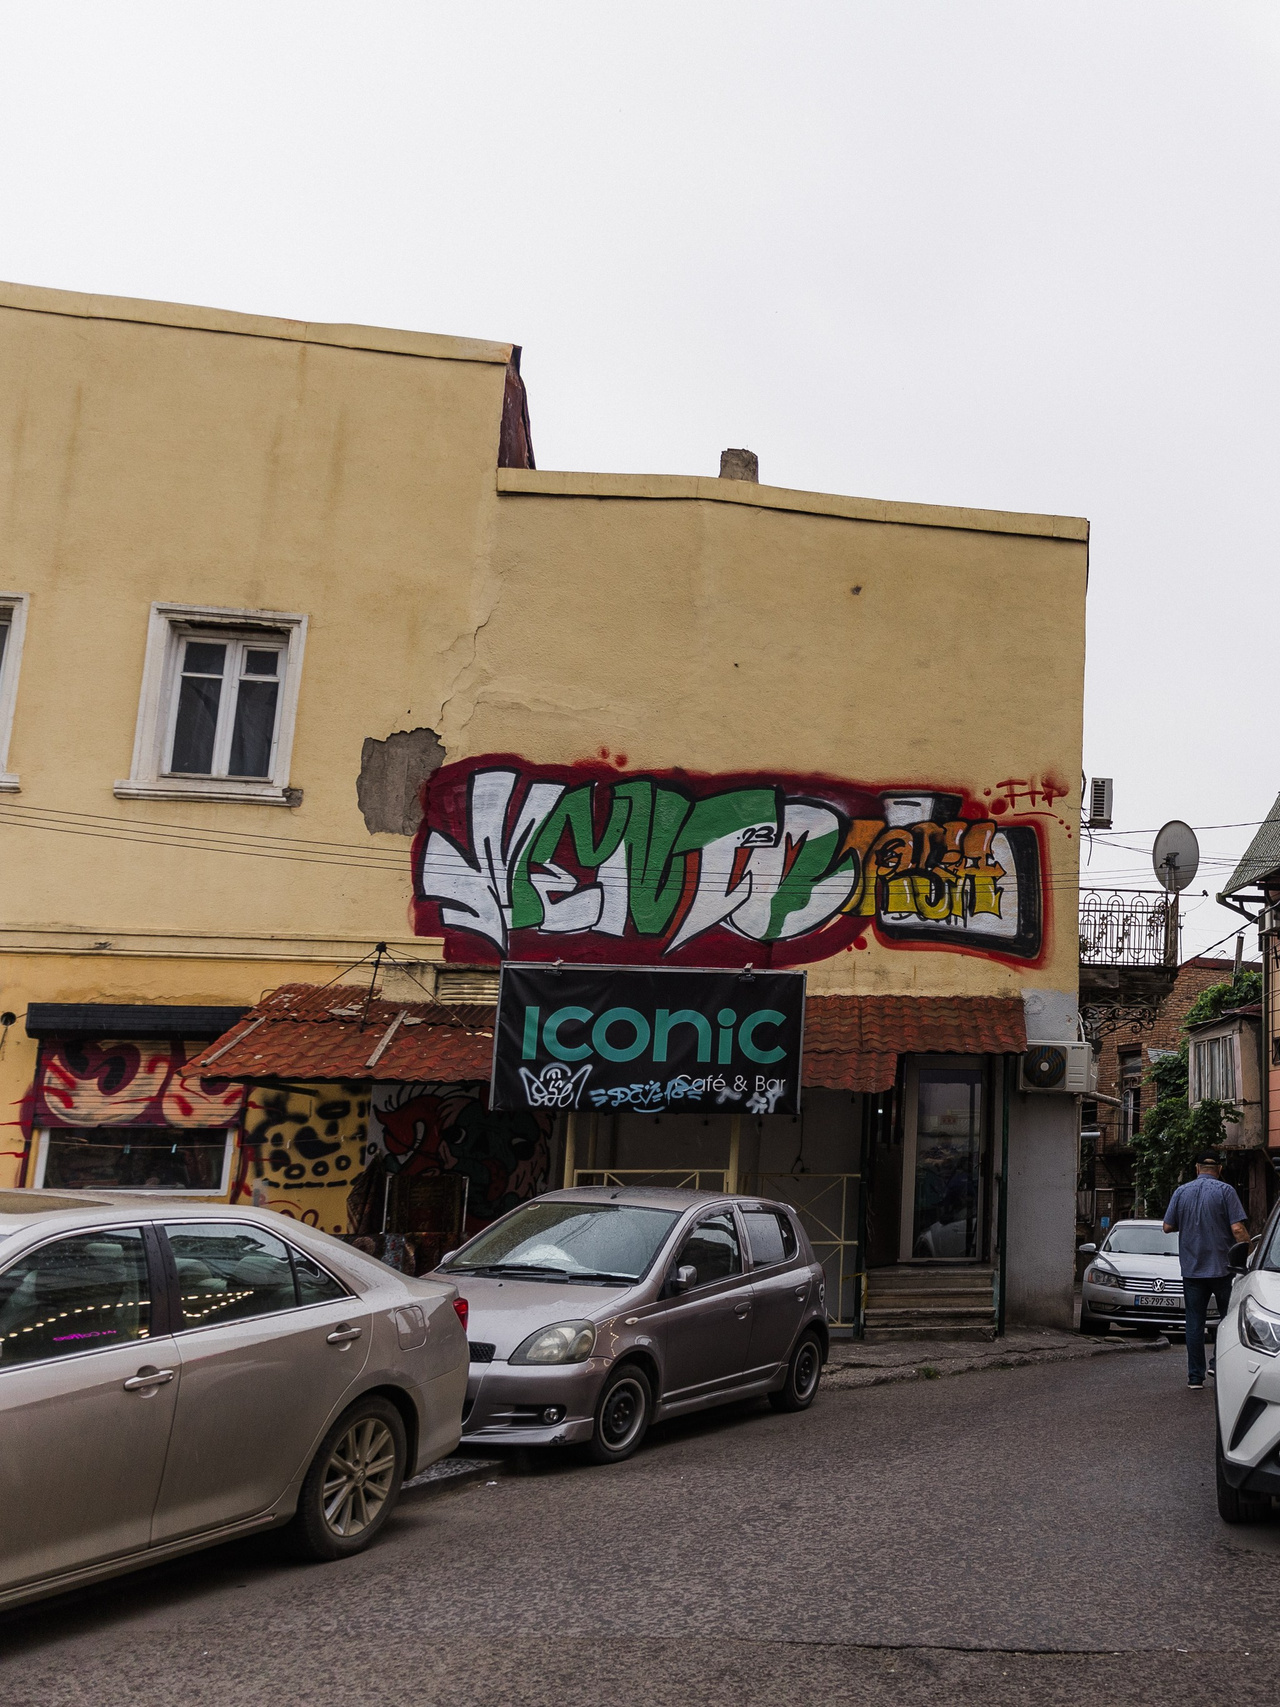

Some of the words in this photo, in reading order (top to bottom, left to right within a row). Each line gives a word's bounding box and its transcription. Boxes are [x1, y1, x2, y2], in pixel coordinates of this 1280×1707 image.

[675, 1073, 726, 1092] Café
[733, 1074, 748, 1092] &
[755, 1074, 786, 1092] Bar
